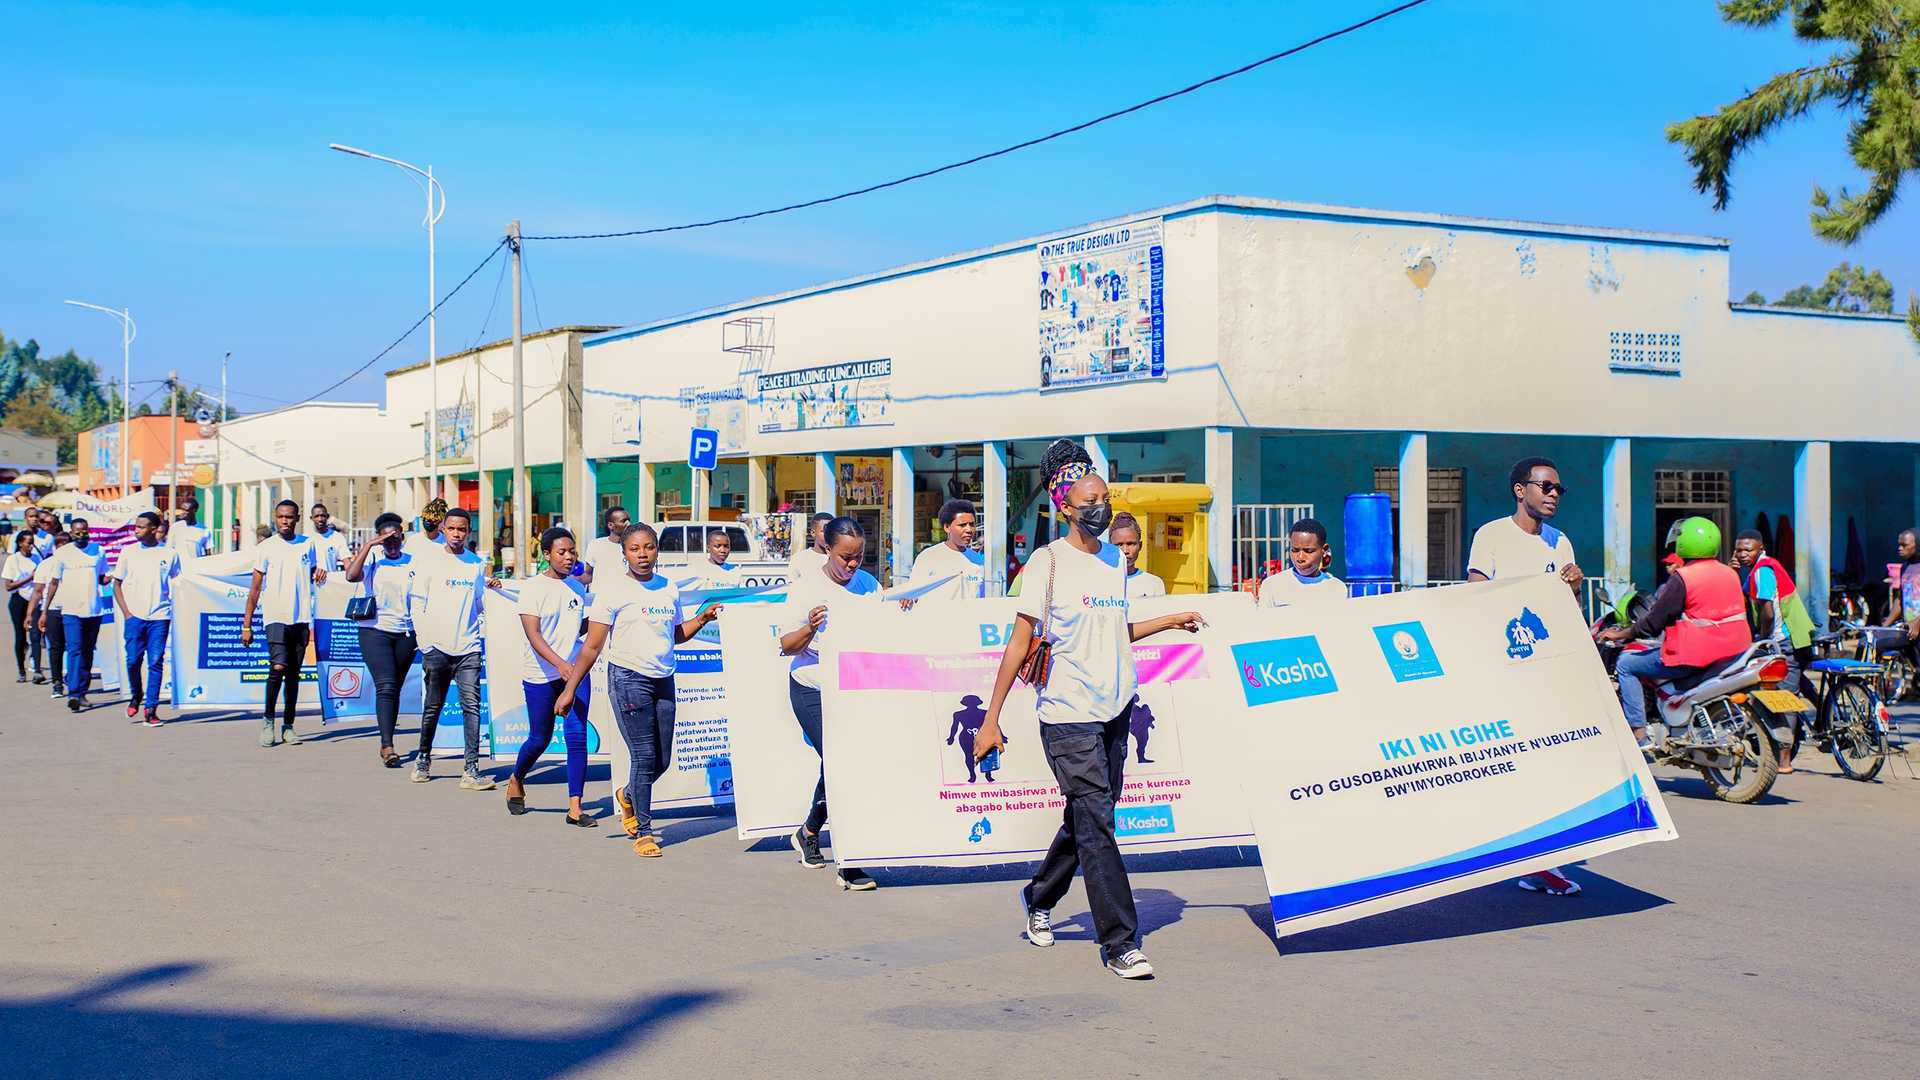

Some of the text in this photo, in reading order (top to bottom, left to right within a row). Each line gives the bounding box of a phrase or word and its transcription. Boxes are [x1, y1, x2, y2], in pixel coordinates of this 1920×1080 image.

[1051, 242, 1065, 257] THE
[1067, 238, 1086, 254] TRUE
[1087, 232, 1115, 250] DESIGN
[1116, 228, 1131, 244] LTD
[758, 374, 784, 391] PEACE
[790, 369, 826, 386] TRADING
[826, 359, 891, 381] QUINCAILLERIE
[694, 436, 713, 460] P
[648, 606, 675, 615] Kasha
[1091, 595, 1125, 608] Kasha
[1259, 656, 1329, 687] Kasha
[698, 717, 728, 726] waragiz
[675, 728, 707, 738] gufatwa
[695, 735, 722, 743] utifuza
[1379, 719, 1515, 761] IKI NI IGIHE
[677, 743, 727, 753] nderabuzima
[677, 754, 699, 763] kujya
[1289, 725, 1603, 801] CYO GUSOBANUKIRWA IBIJYANYE N'UBUZIMA
[939, 790, 977, 800] Nimwe
[980, 787, 1047, 799] mwibasirwa
[1124, 782, 1144, 791] ane
[1146, 778, 1191, 789] kurenza
[1383, 761, 1517, 799] BW'IMYOROROKERE
[956, 803, 1003, 814] abagabo
[1005, 800, 1045, 811] kubera
[1149, 792, 1182, 804] yanyu
[1127, 815, 1169, 830] Kasha
